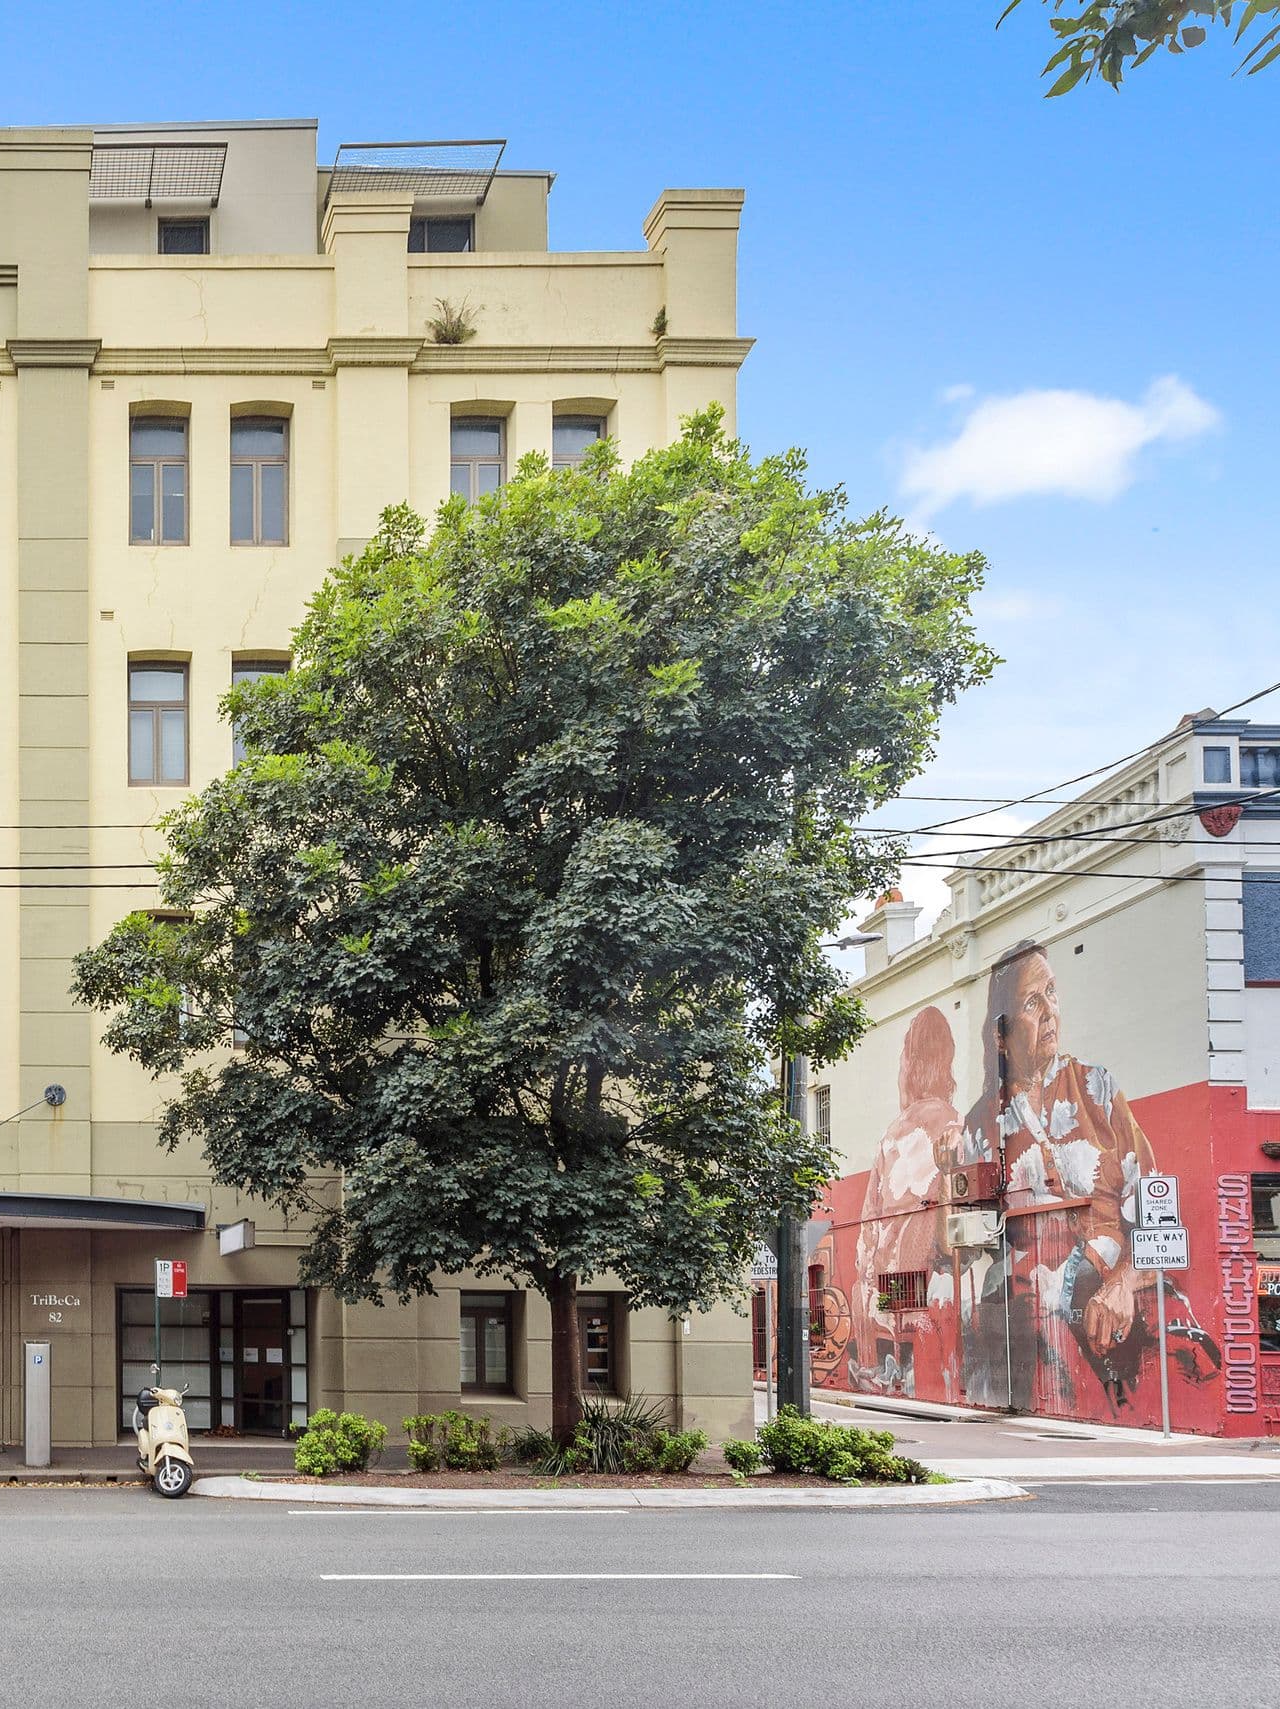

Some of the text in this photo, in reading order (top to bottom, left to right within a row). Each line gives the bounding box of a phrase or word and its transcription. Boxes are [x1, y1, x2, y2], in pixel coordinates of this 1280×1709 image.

[1153, 1184, 1165, 1194] 10
[1136, 1233, 1184, 1243] GIVE WAY
[1156, 1244, 1168, 1253] TO
[765, 1255, 776, 1264] TO
[160, 1263, 170, 1272] 1P
[29, 1294, 81, 1306] TriBeCa
[48, 1311, 63, 1323] 82
